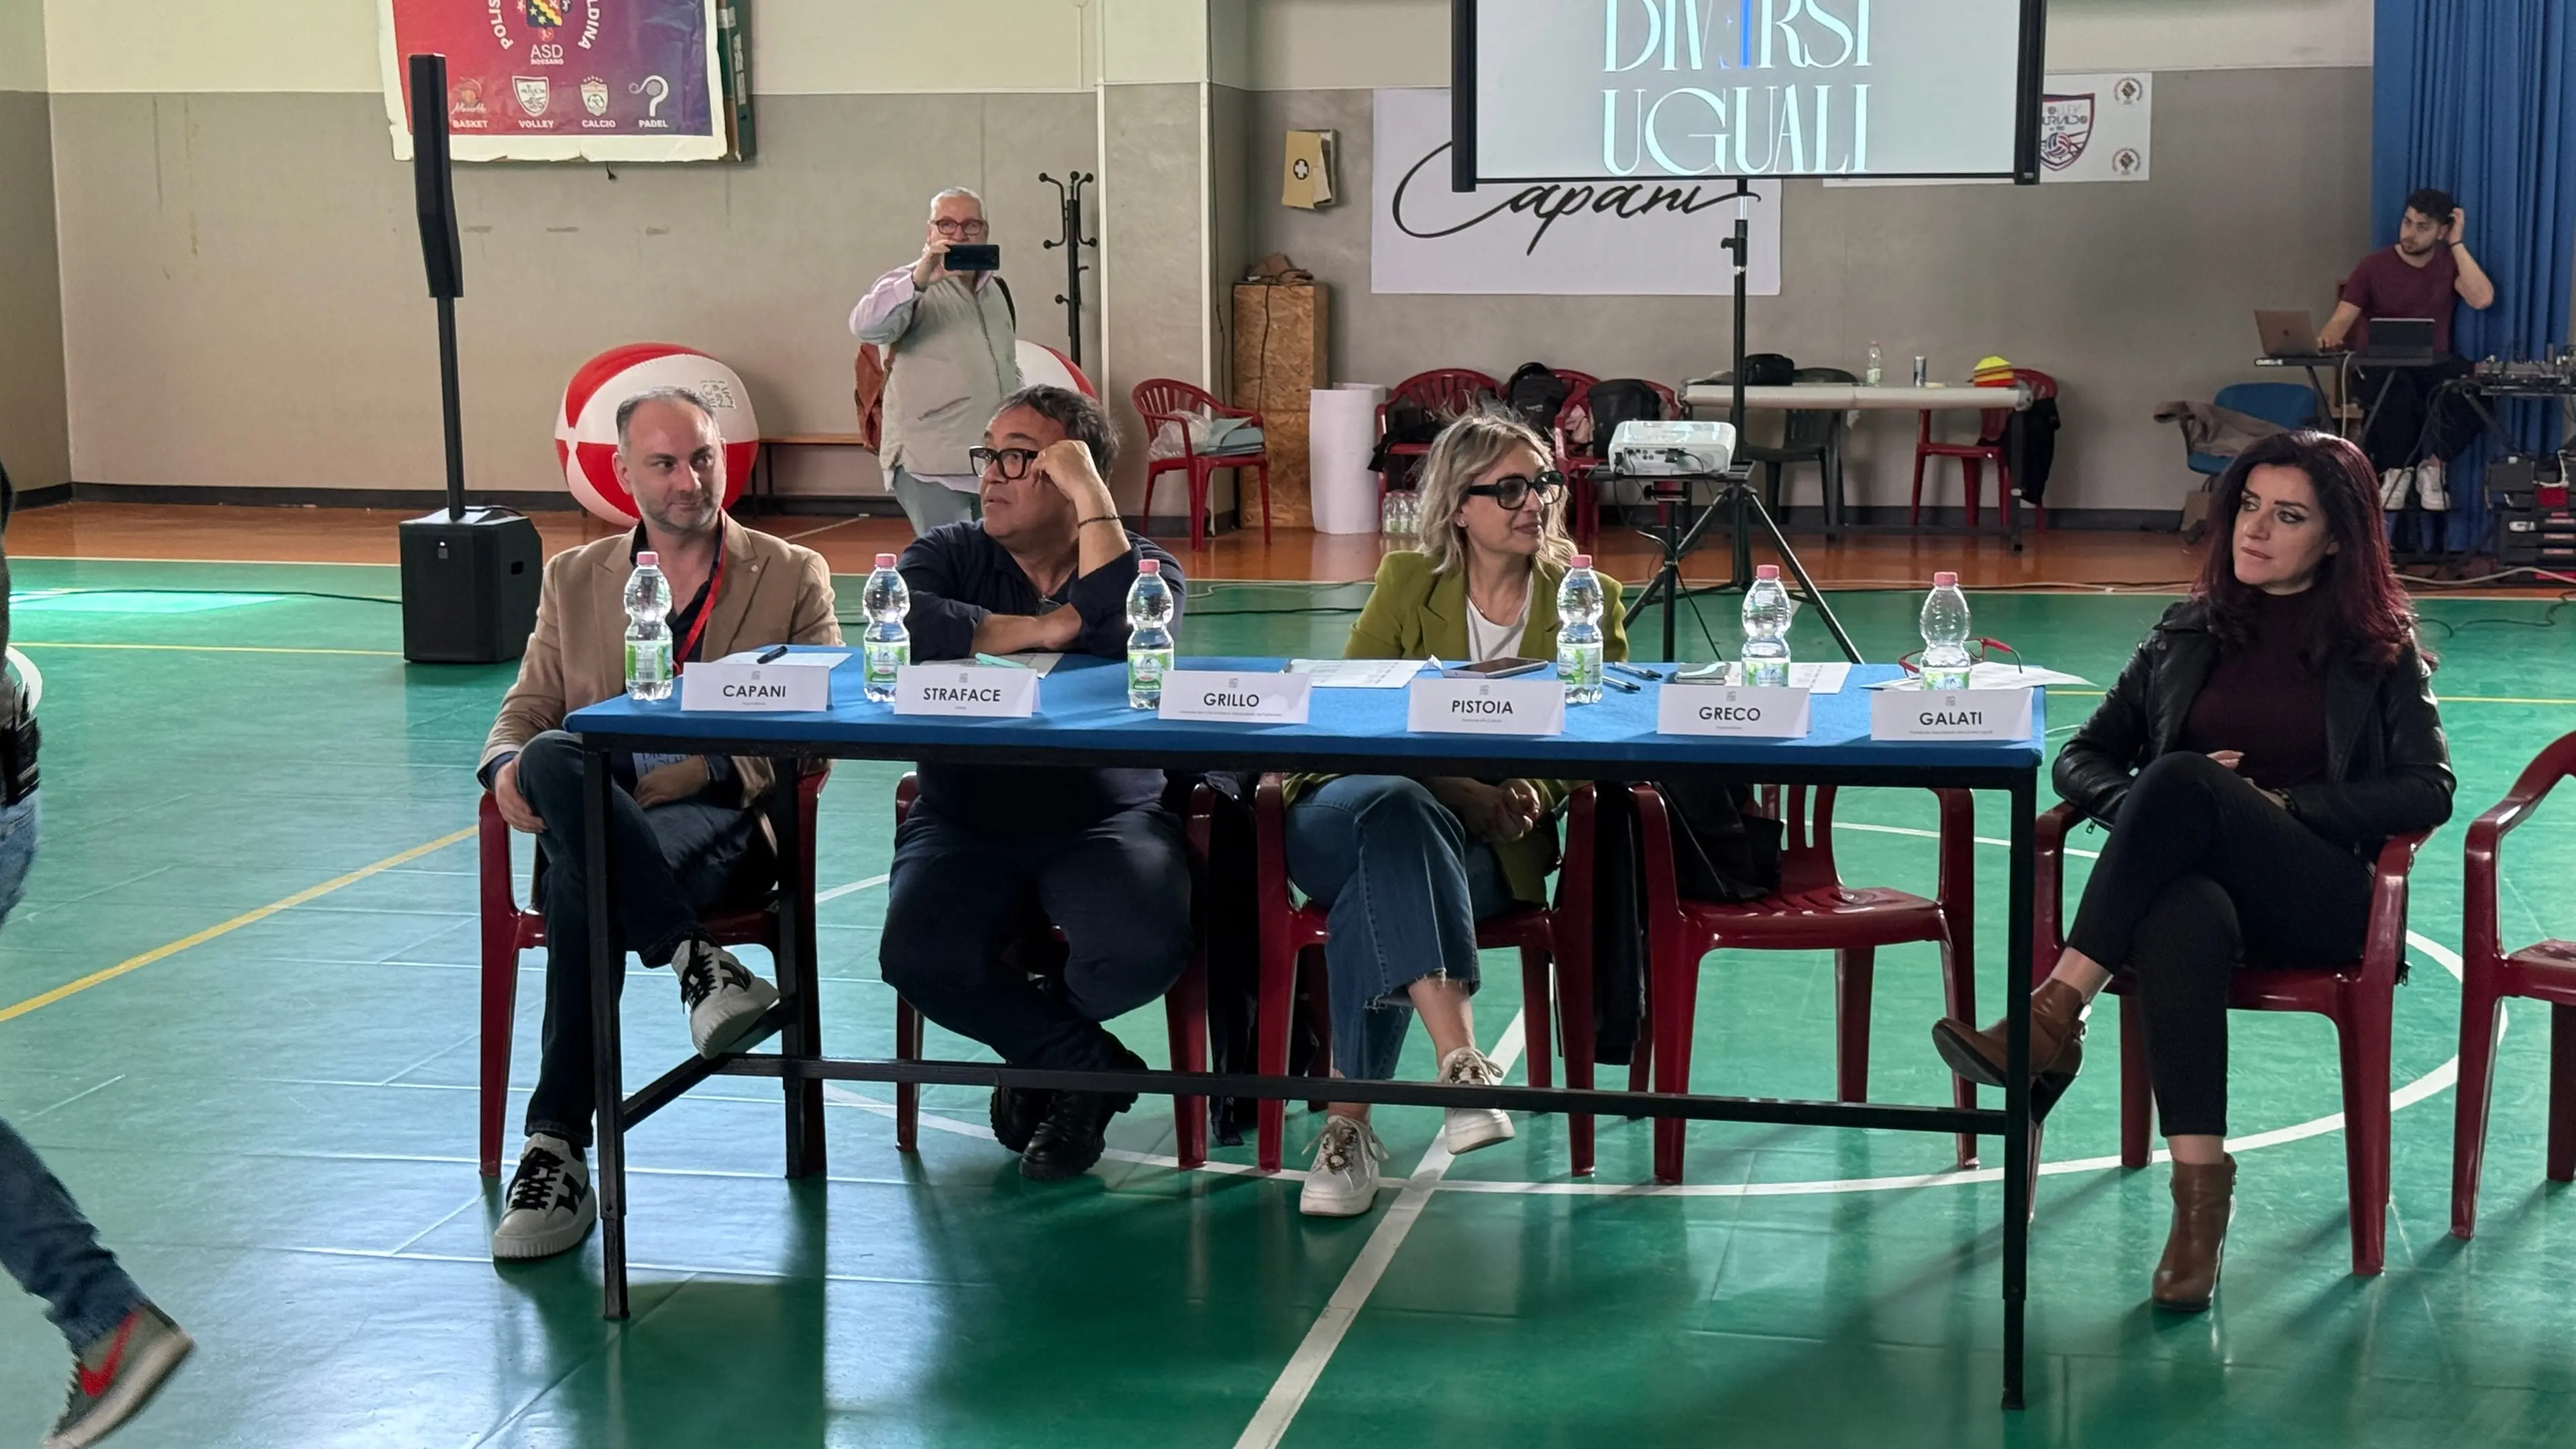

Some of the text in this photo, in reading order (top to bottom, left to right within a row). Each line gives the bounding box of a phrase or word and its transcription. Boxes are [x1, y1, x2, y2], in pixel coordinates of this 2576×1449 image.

[530, 44, 564, 58] ASD
[452, 119, 488, 128] BASKET
[518, 119, 554, 128] VOLLEY
[582, 119, 616, 128] CALCIO
[638, 119, 669, 128] PADEL
[1601, 83, 1872, 176] UGUALI
[1392, 141, 1762, 256] Capani
[722, 684, 786, 698] CAPANI
[922, 687, 1001, 702] STRAFACE
[1203, 692, 1260, 708] GRILLO
[1451, 699, 1514, 714] PISTOIA
[1699, 706, 1761, 721] GRECO
[1919, 711, 1982, 726] GALATI
